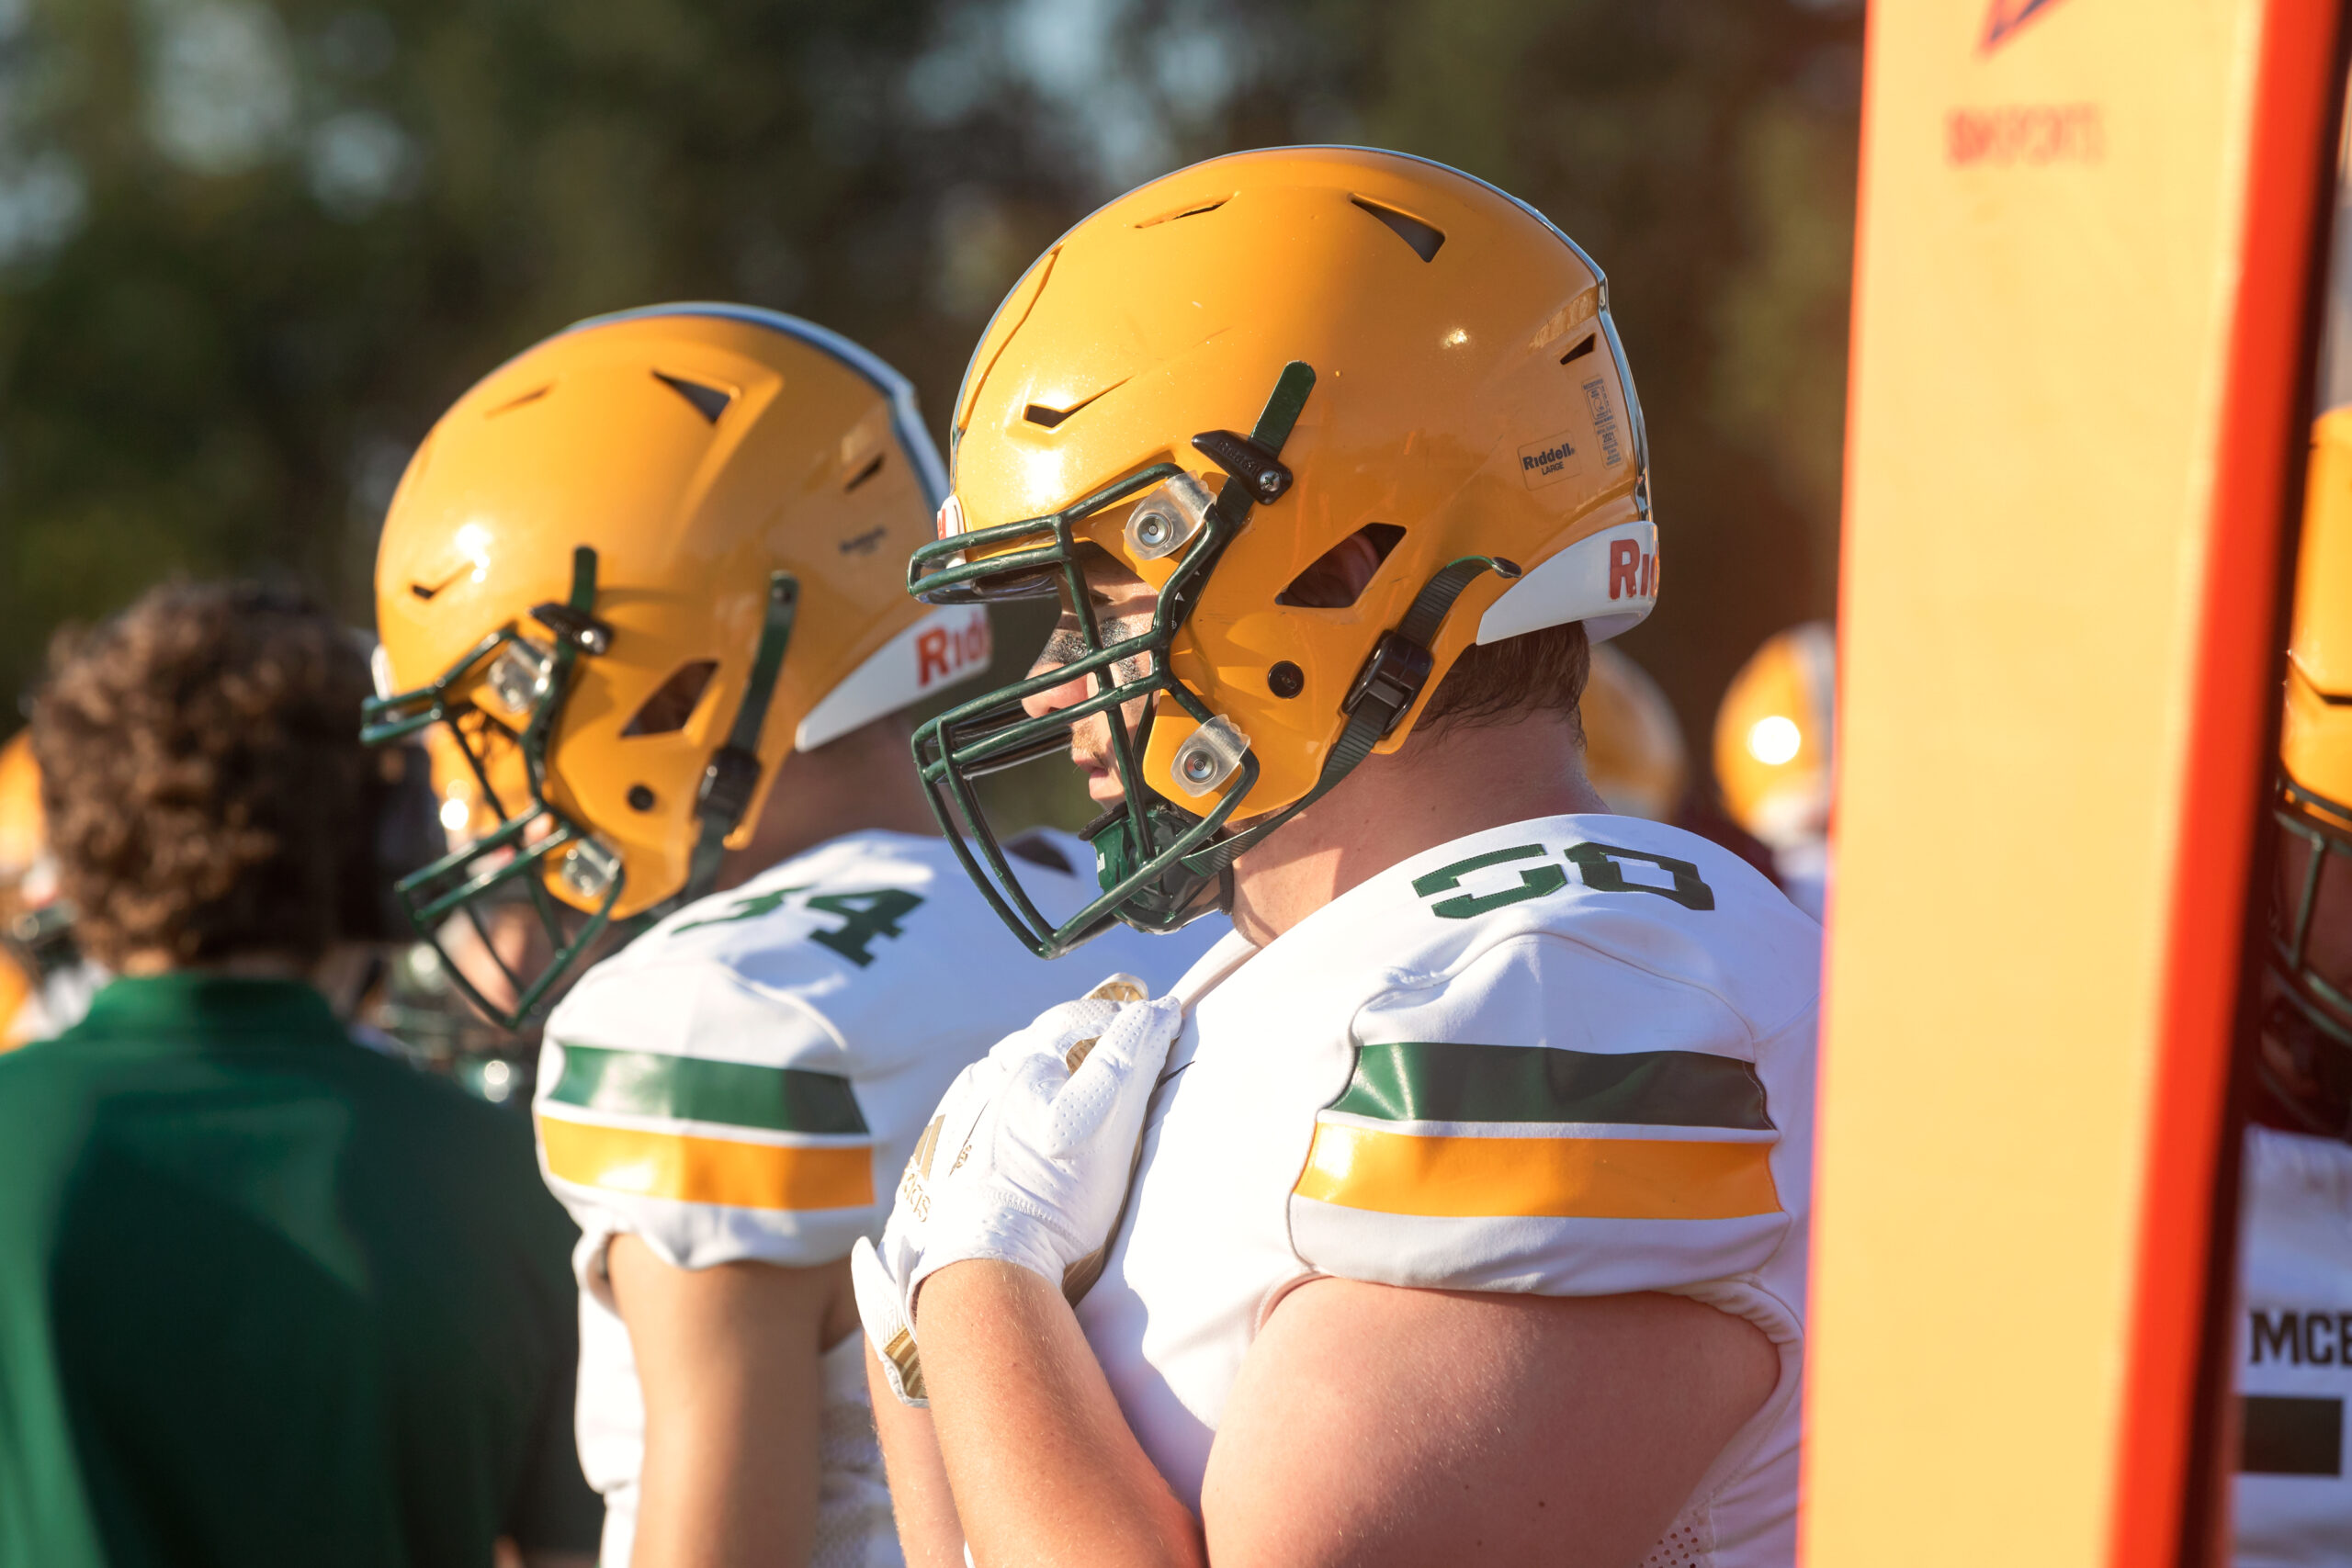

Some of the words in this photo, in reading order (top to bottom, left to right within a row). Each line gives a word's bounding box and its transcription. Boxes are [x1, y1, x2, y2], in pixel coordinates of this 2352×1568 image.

[1523, 443, 1572, 470] Riddell
[1542, 461, 1565, 475] LARGE
[1411, 841, 1715, 919] 50
